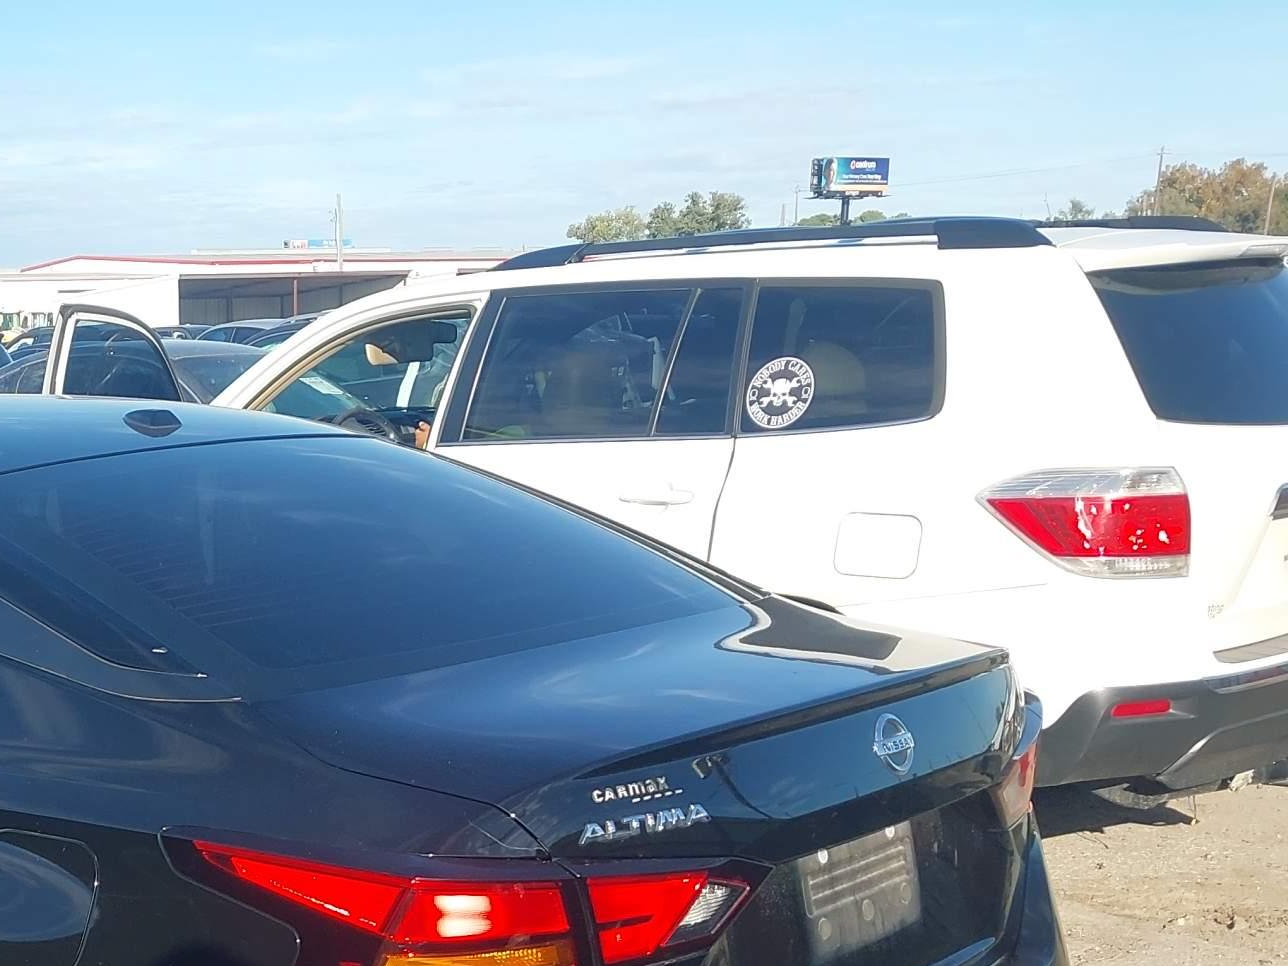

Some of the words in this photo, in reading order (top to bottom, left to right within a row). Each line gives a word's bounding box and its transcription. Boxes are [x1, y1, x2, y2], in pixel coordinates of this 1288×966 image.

[753, 360, 787, 388] NOBODY
[788, 360, 811, 386] CARES
[750, 401, 771, 425] WORK
[770, 401, 806, 426] HARDER
[578, 803, 712, 845] ALTIMA
